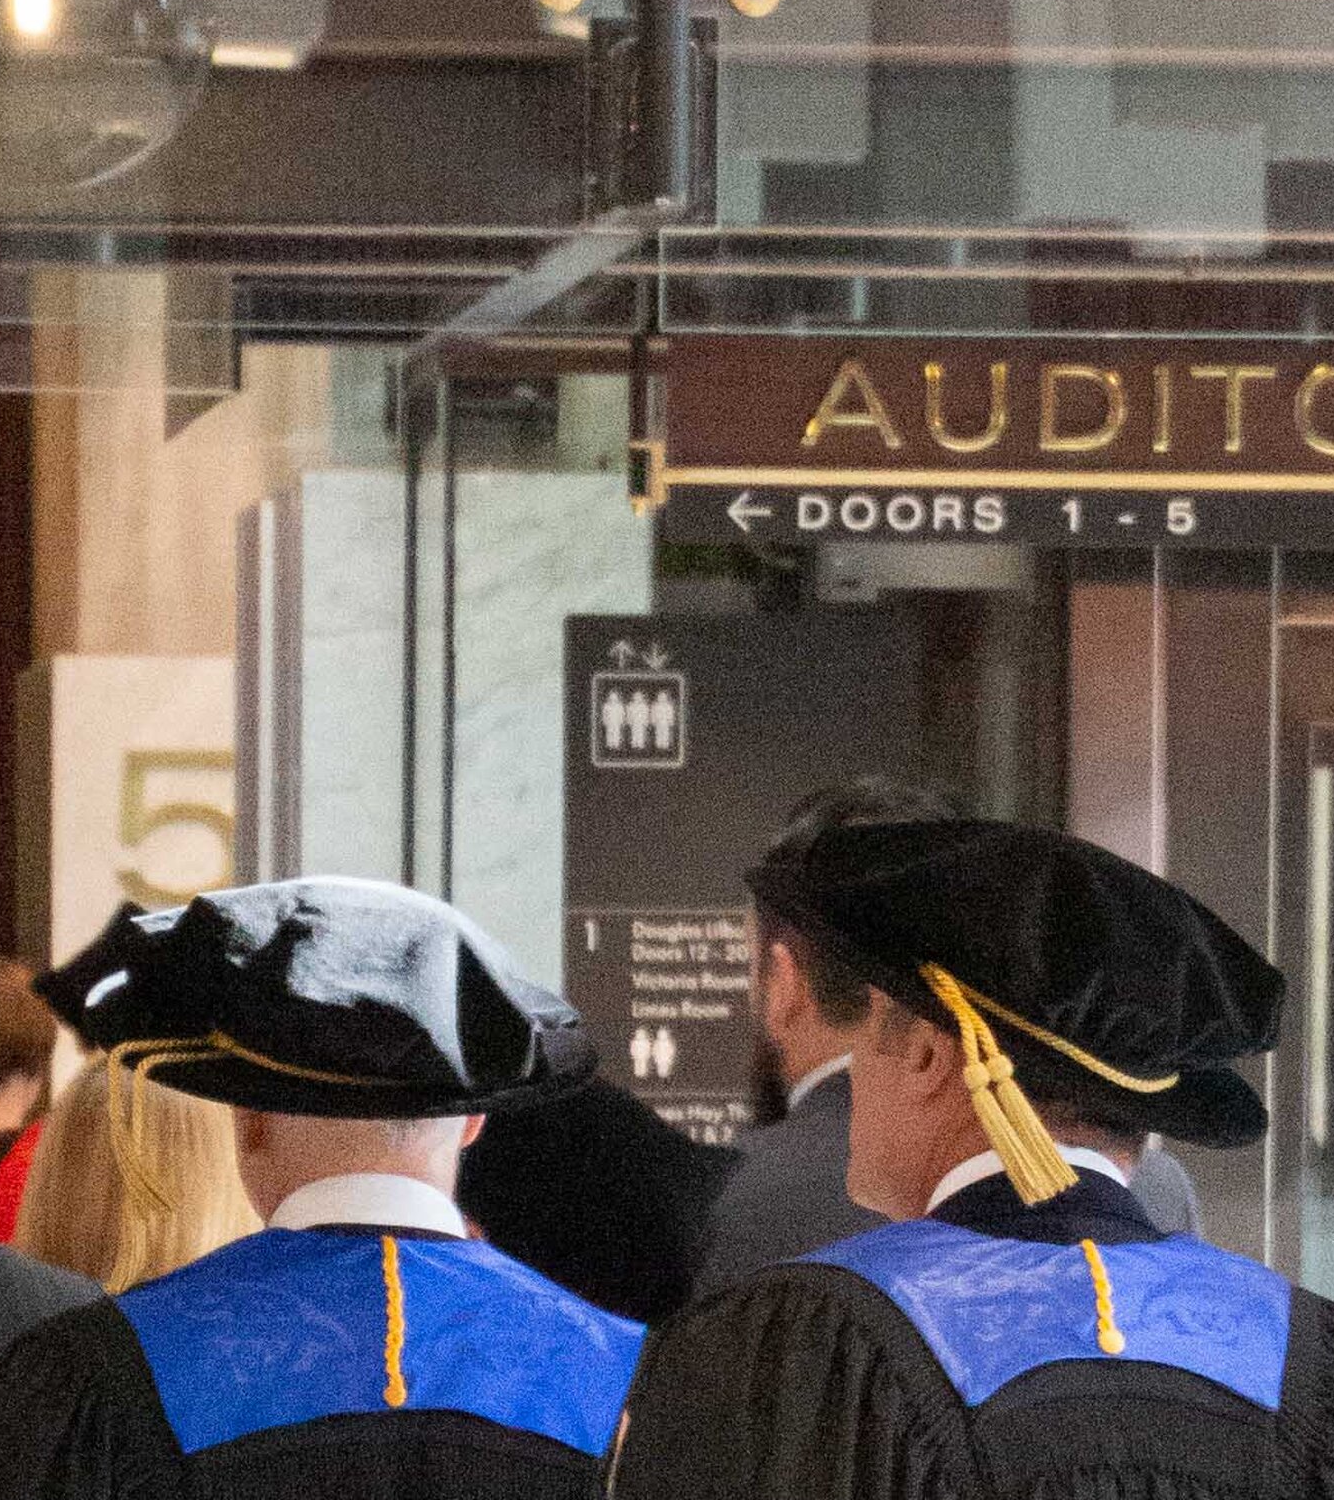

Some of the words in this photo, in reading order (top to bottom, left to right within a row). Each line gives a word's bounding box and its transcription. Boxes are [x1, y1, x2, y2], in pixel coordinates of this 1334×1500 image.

[797, 494, 1006, 534] DOORS
[1063, 499, 1081, 534] 1
[1166, 500, 1197, 536] 5
[117, 750, 235, 908] 5
